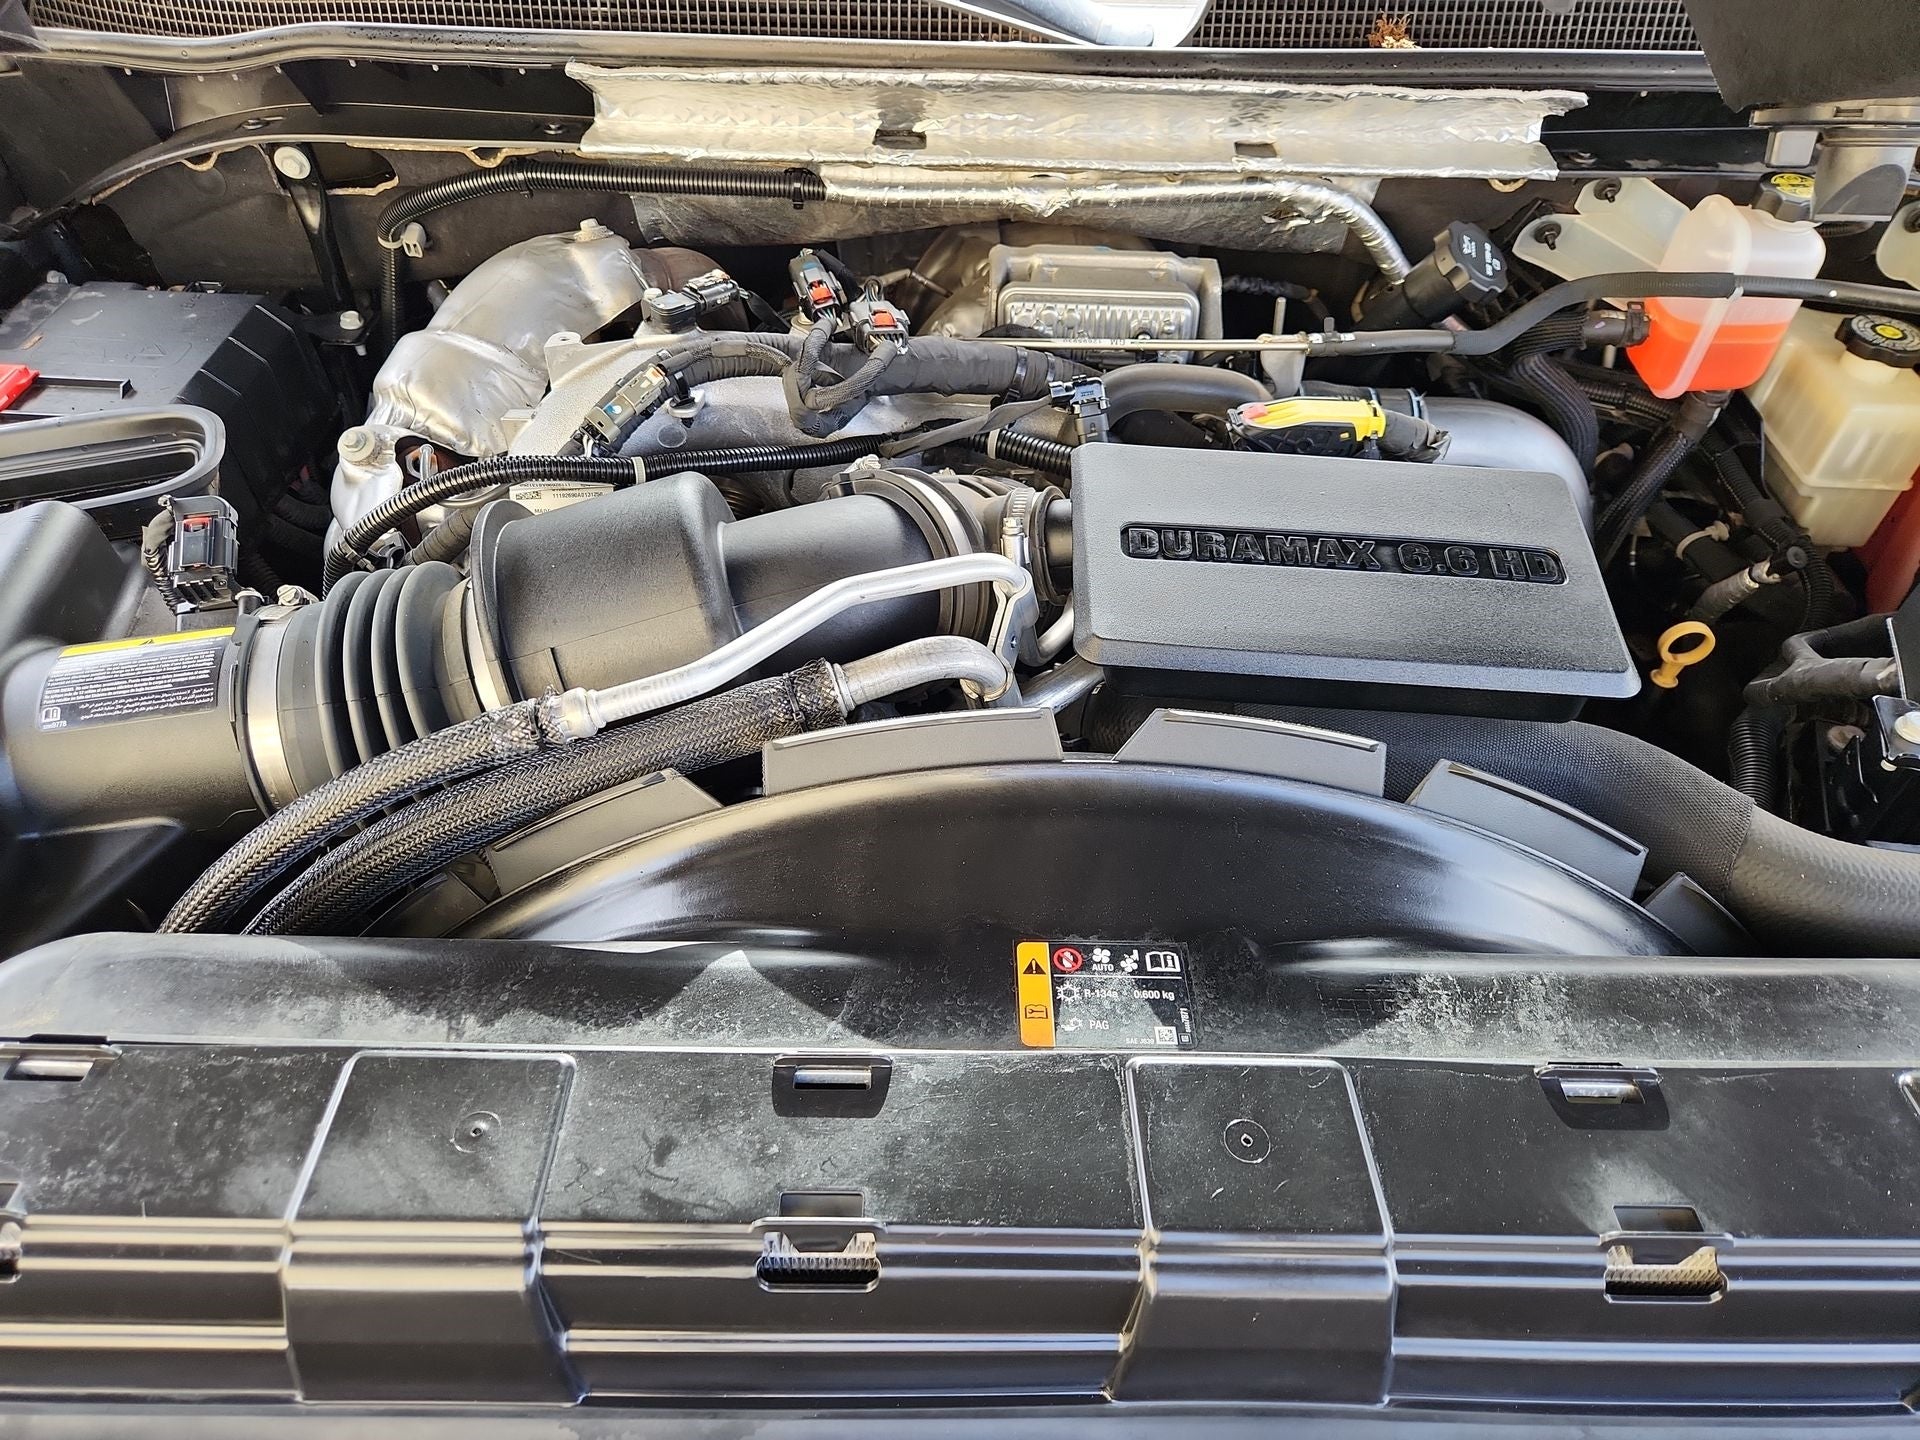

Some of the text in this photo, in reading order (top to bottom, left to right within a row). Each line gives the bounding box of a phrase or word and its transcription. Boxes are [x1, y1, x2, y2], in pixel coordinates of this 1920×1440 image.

[1128, 527, 1562, 582] DURAMAX 6.6 HD
[1091, 963, 1114, 972] AUTO
[1084, 988, 1176, 1002] R-134a 0.600 kg
[1089, 1020, 1110, 1030] PAG
